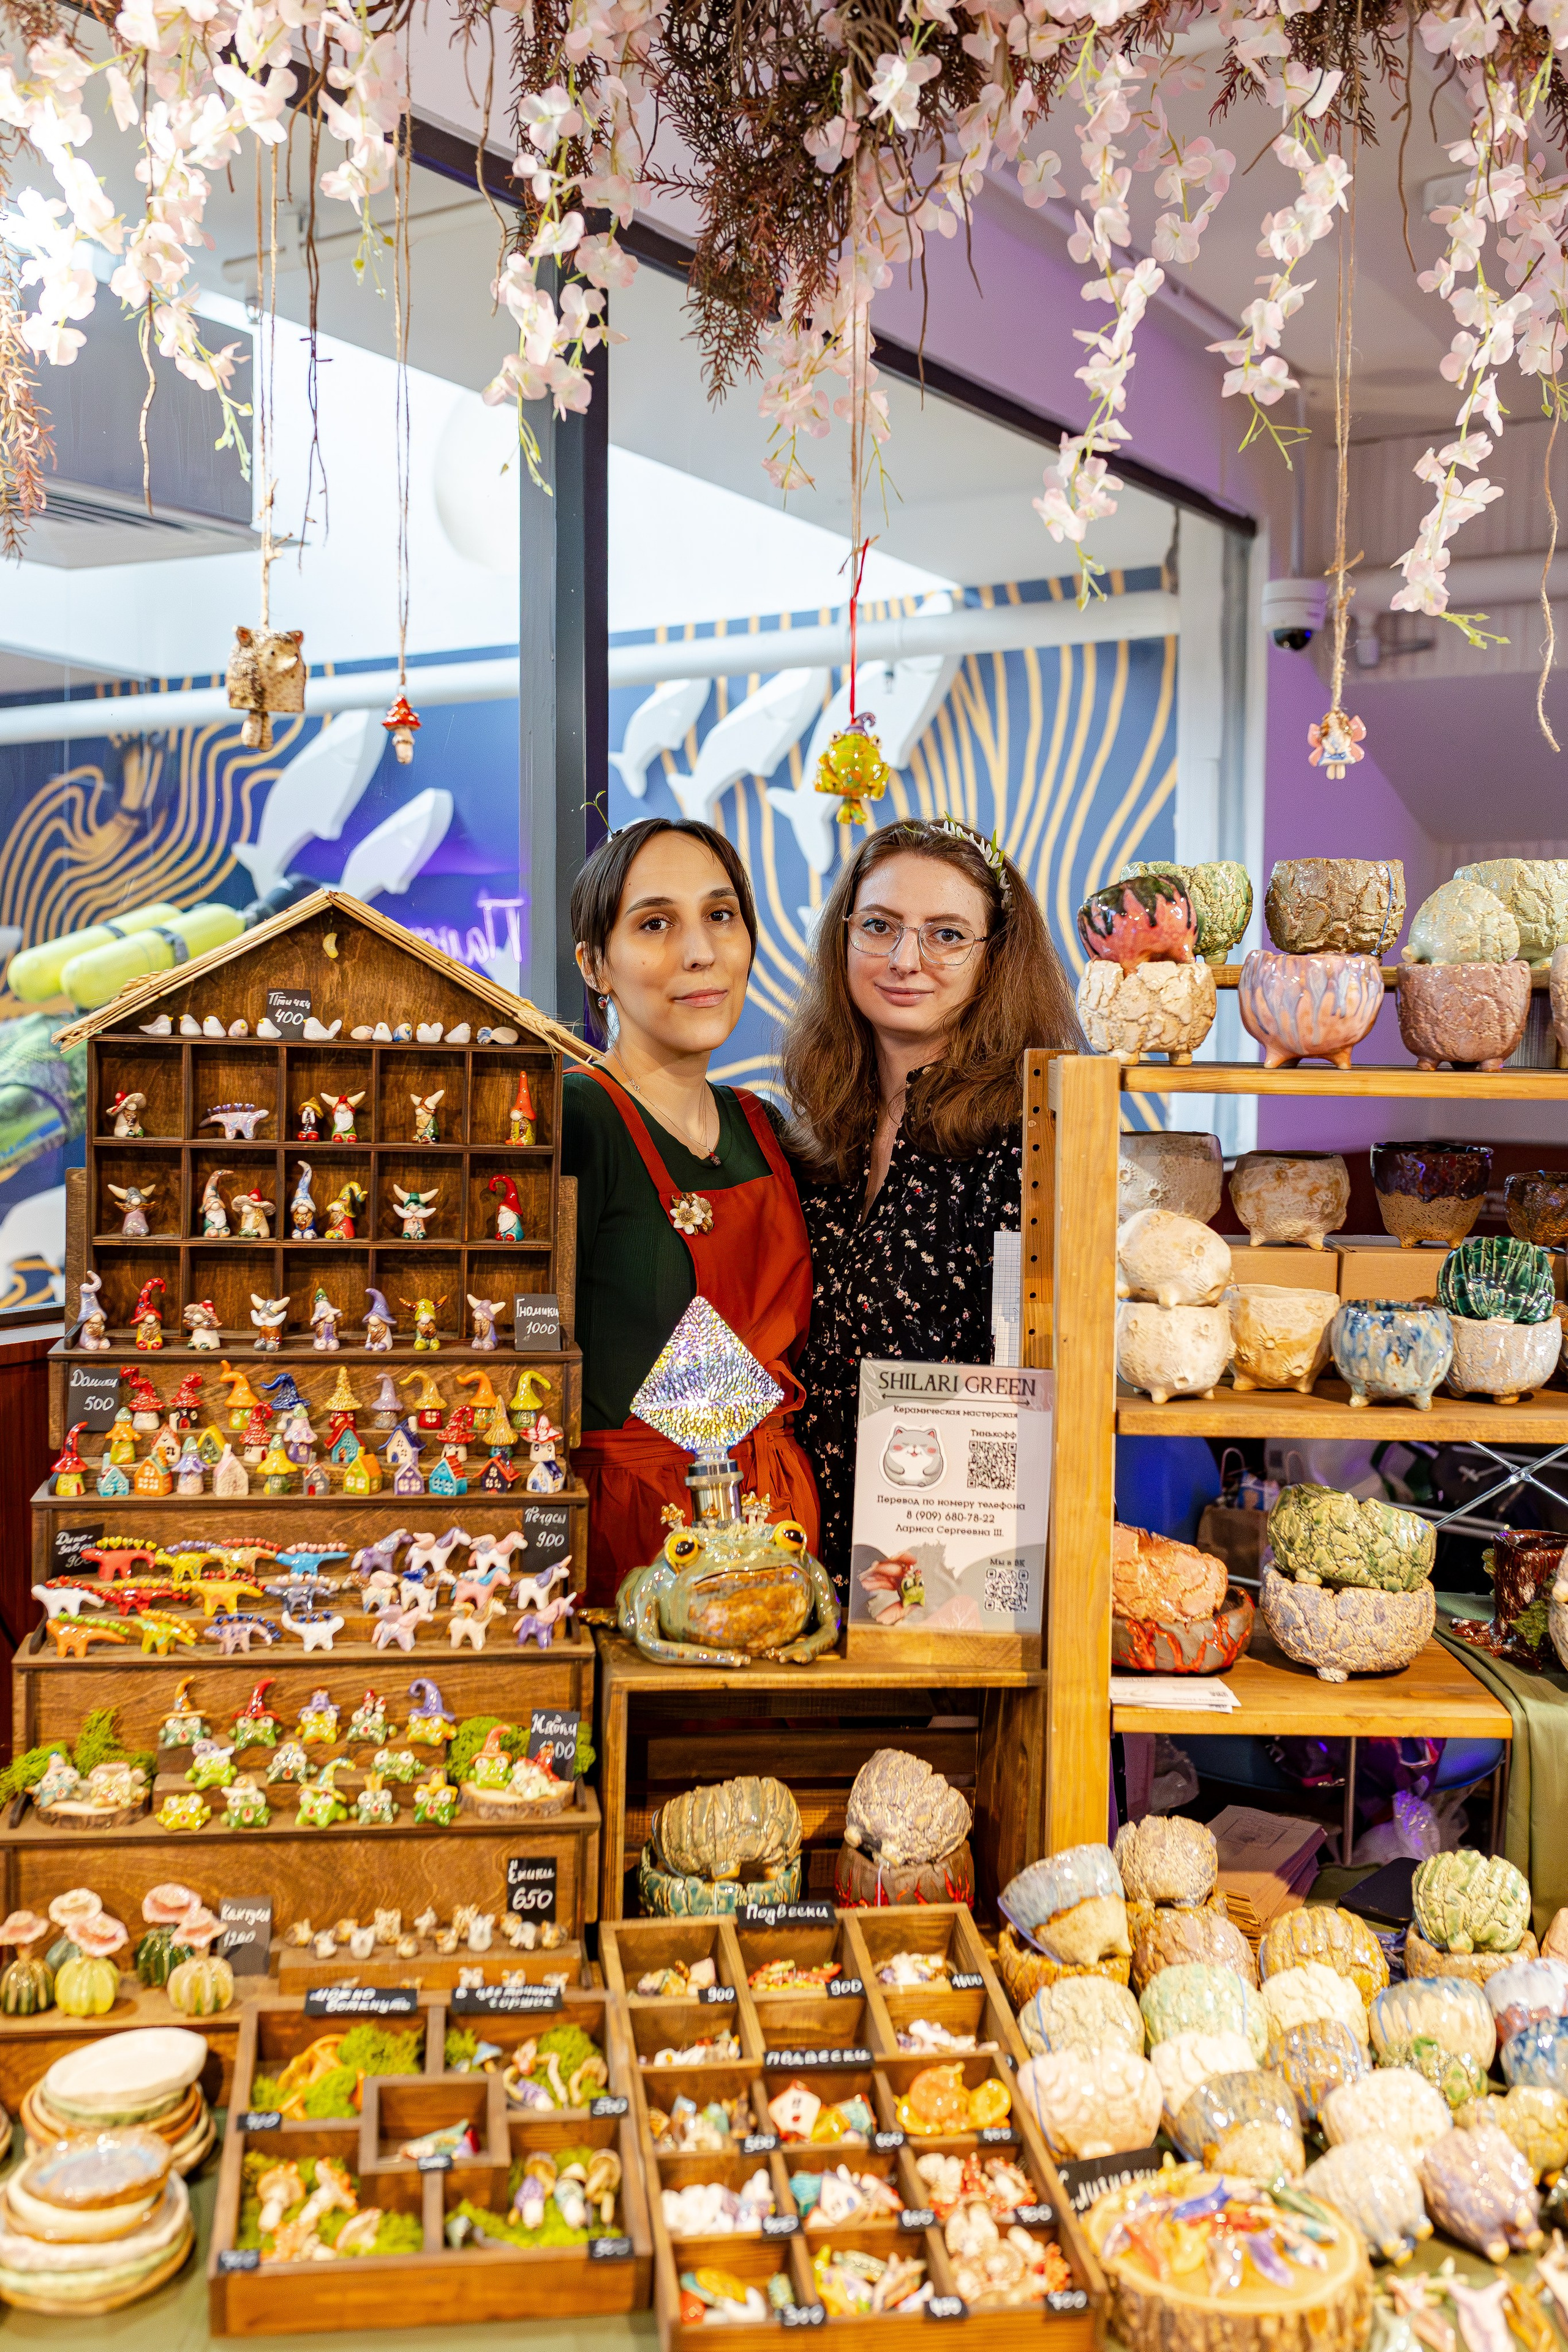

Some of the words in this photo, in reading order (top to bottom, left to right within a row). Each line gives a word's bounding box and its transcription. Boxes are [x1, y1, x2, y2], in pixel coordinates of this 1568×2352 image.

[268, 992, 311, 1009] Птички
[275, 1009, 304, 1025] 400
[516, 1298, 559, 1317] Гномики
[526, 1321, 557, 1335] 1000
[70, 1369, 118, 1388] Домики
[879, 1372, 958, 1392] SHILARI
[965, 1376, 1036, 1396] GREEN
[84, 1396, 115, 1411] 500
[894, 1405, 960, 1416] Керамическая
[963, 1410, 1017, 1419] мастерская
[971, 1429, 1017, 1439] Тинькофф
[877, 1495, 919, 1506] Перевод
[938, 1501, 974, 1509] номеру
[978, 1501, 1025, 1511] телефона
[525, 1506, 567, 1526] Пегасы
[907, 1510, 912, 1519] 8
[916, 1511, 941, 1521] (909)
[945, 1513, 995, 1523] 680-78-22
[895, 1524, 933, 1534] Лариса
[937, 1526, 990, 1536] Сергеевна
[536, 1531, 564, 1547] 900
[512, 1887, 553, 1910] 650
[746, 1903, 828, 1926] Подвески
[707, 1986, 734, 2002] 900
[831, 1978, 862, 1996] 900
